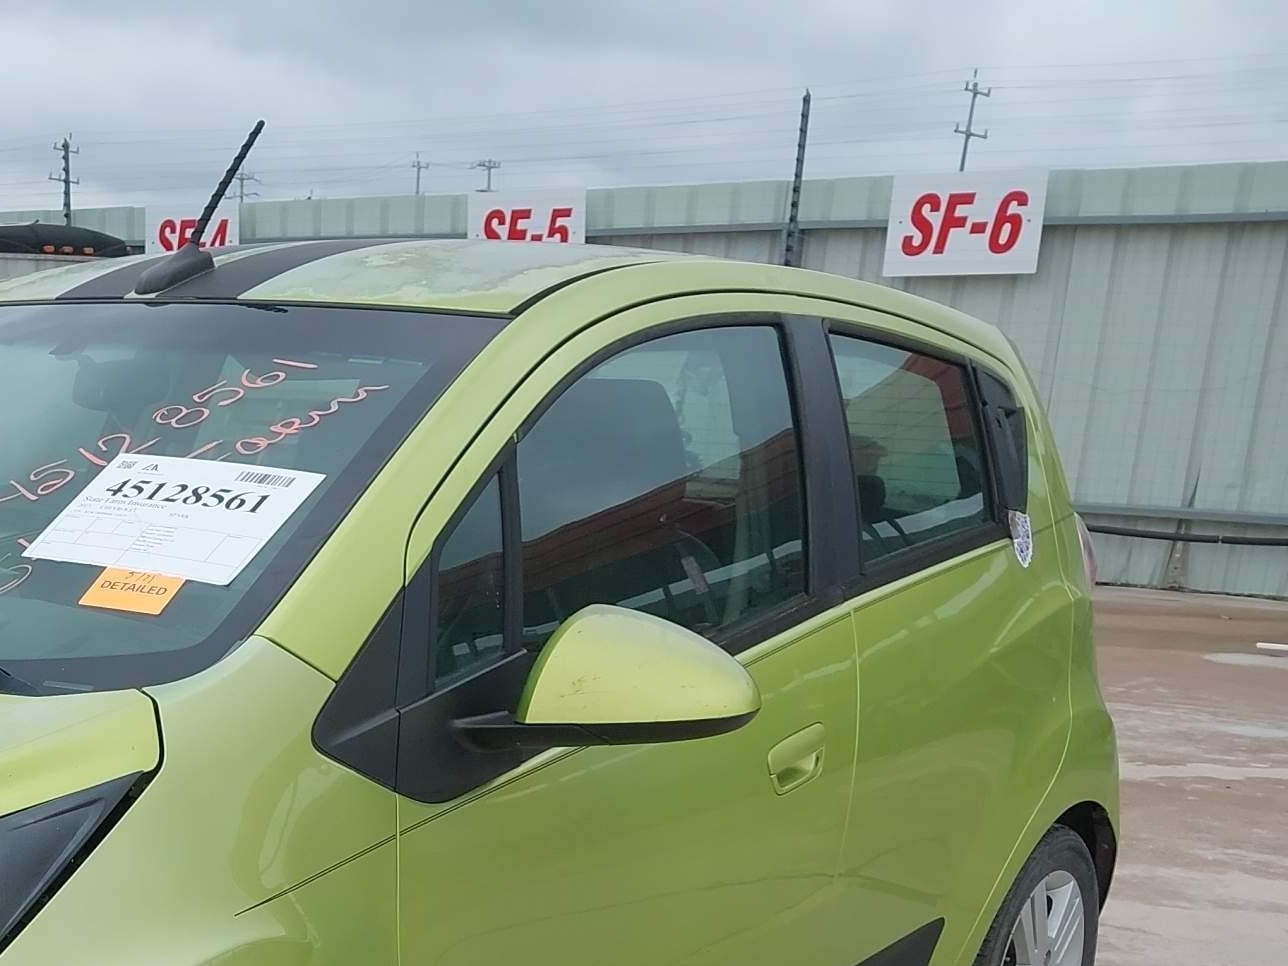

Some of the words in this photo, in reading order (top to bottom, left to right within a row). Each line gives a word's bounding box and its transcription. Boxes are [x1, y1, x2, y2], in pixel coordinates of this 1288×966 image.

[484, 208, 573, 243] SF-5
[902, 191, 1029, 256] SF-6
[106, 478, 271, 514] 45128561
[101, 580, 168, 596] DETAILED
